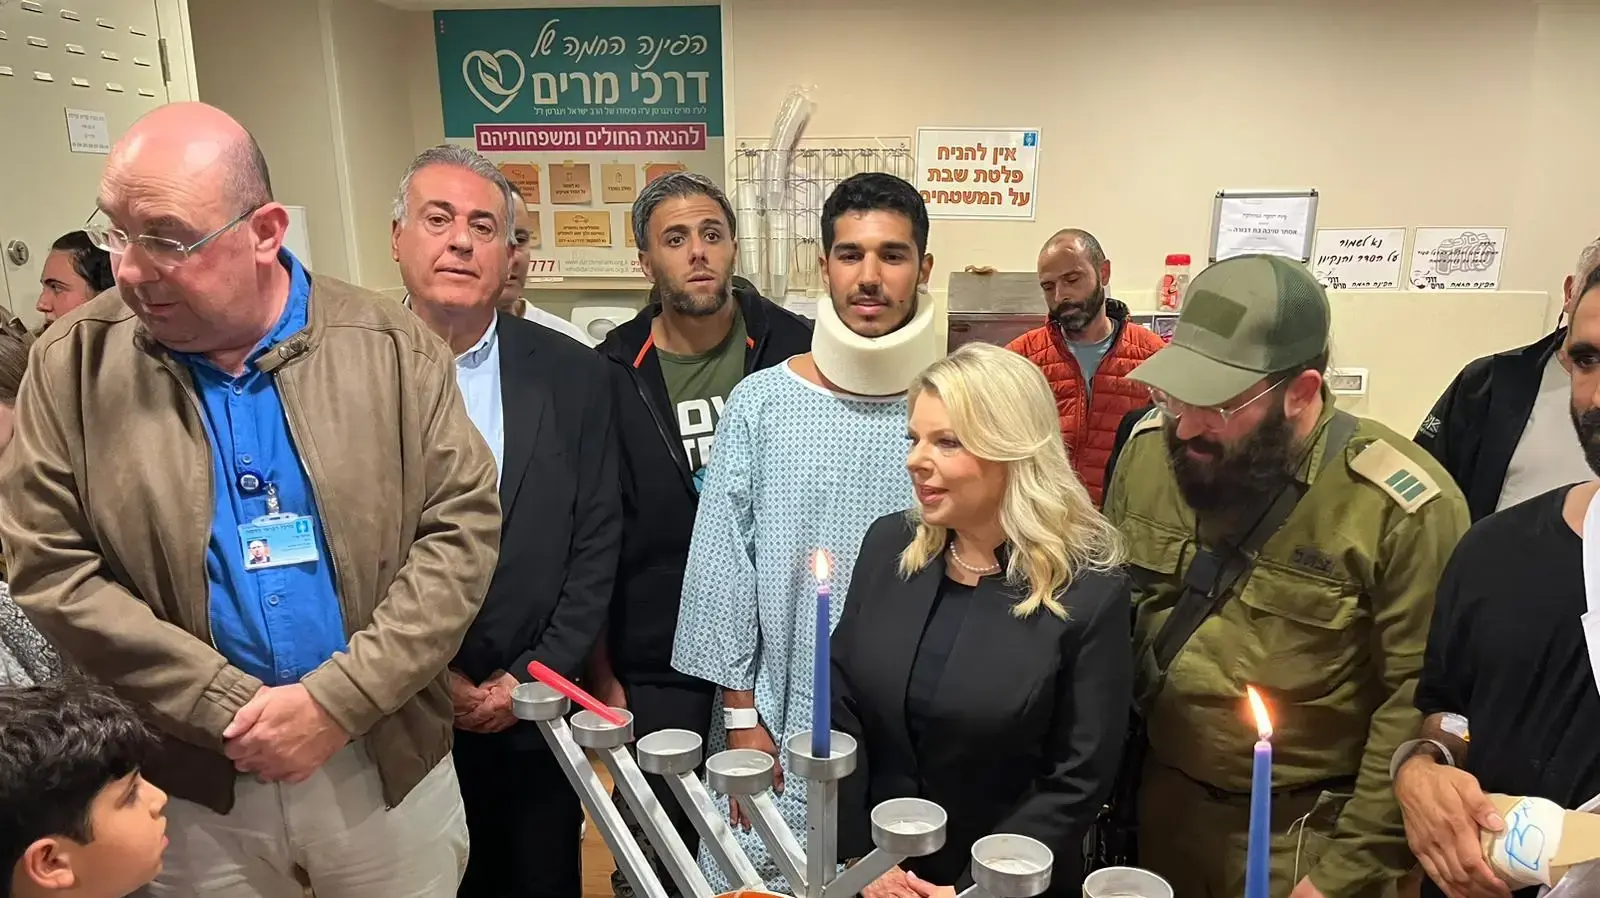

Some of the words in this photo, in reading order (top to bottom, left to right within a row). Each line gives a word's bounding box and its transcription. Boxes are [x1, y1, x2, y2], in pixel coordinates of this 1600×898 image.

[530, 18, 560, 58] של
[562, 35, 626, 64] החמה
[634, 34, 708, 70] הפינה
[532, 71, 620, 105] מרים
[631, 71, 710, 105] דרכי
[567, 106, 589, 116] ישראל
[589, 107, 603, 115] הרב
[604, 106, 615, 115] של
[479, 129, 581, 147] ומשפחותיהם
[585, 126, 642, 146] החולים
[645, 127, 701, 146] להנאת
[937, 143, 987, 161] להניח
[992, 146, 1017, 165] אין
[927, 168, 969, 183] שבת
[972, 165, 1024, 184] פלטת
[920, 190, 1003, 205] המשטחים
[1008, 187, 1031, 207] על
[1339, 234, 1373, 249] לשמור
[1370, 237, 1383, 248] נא
[1357, 254, 1384, 263] הסדר
[1386, 250, 1400, 262] על
